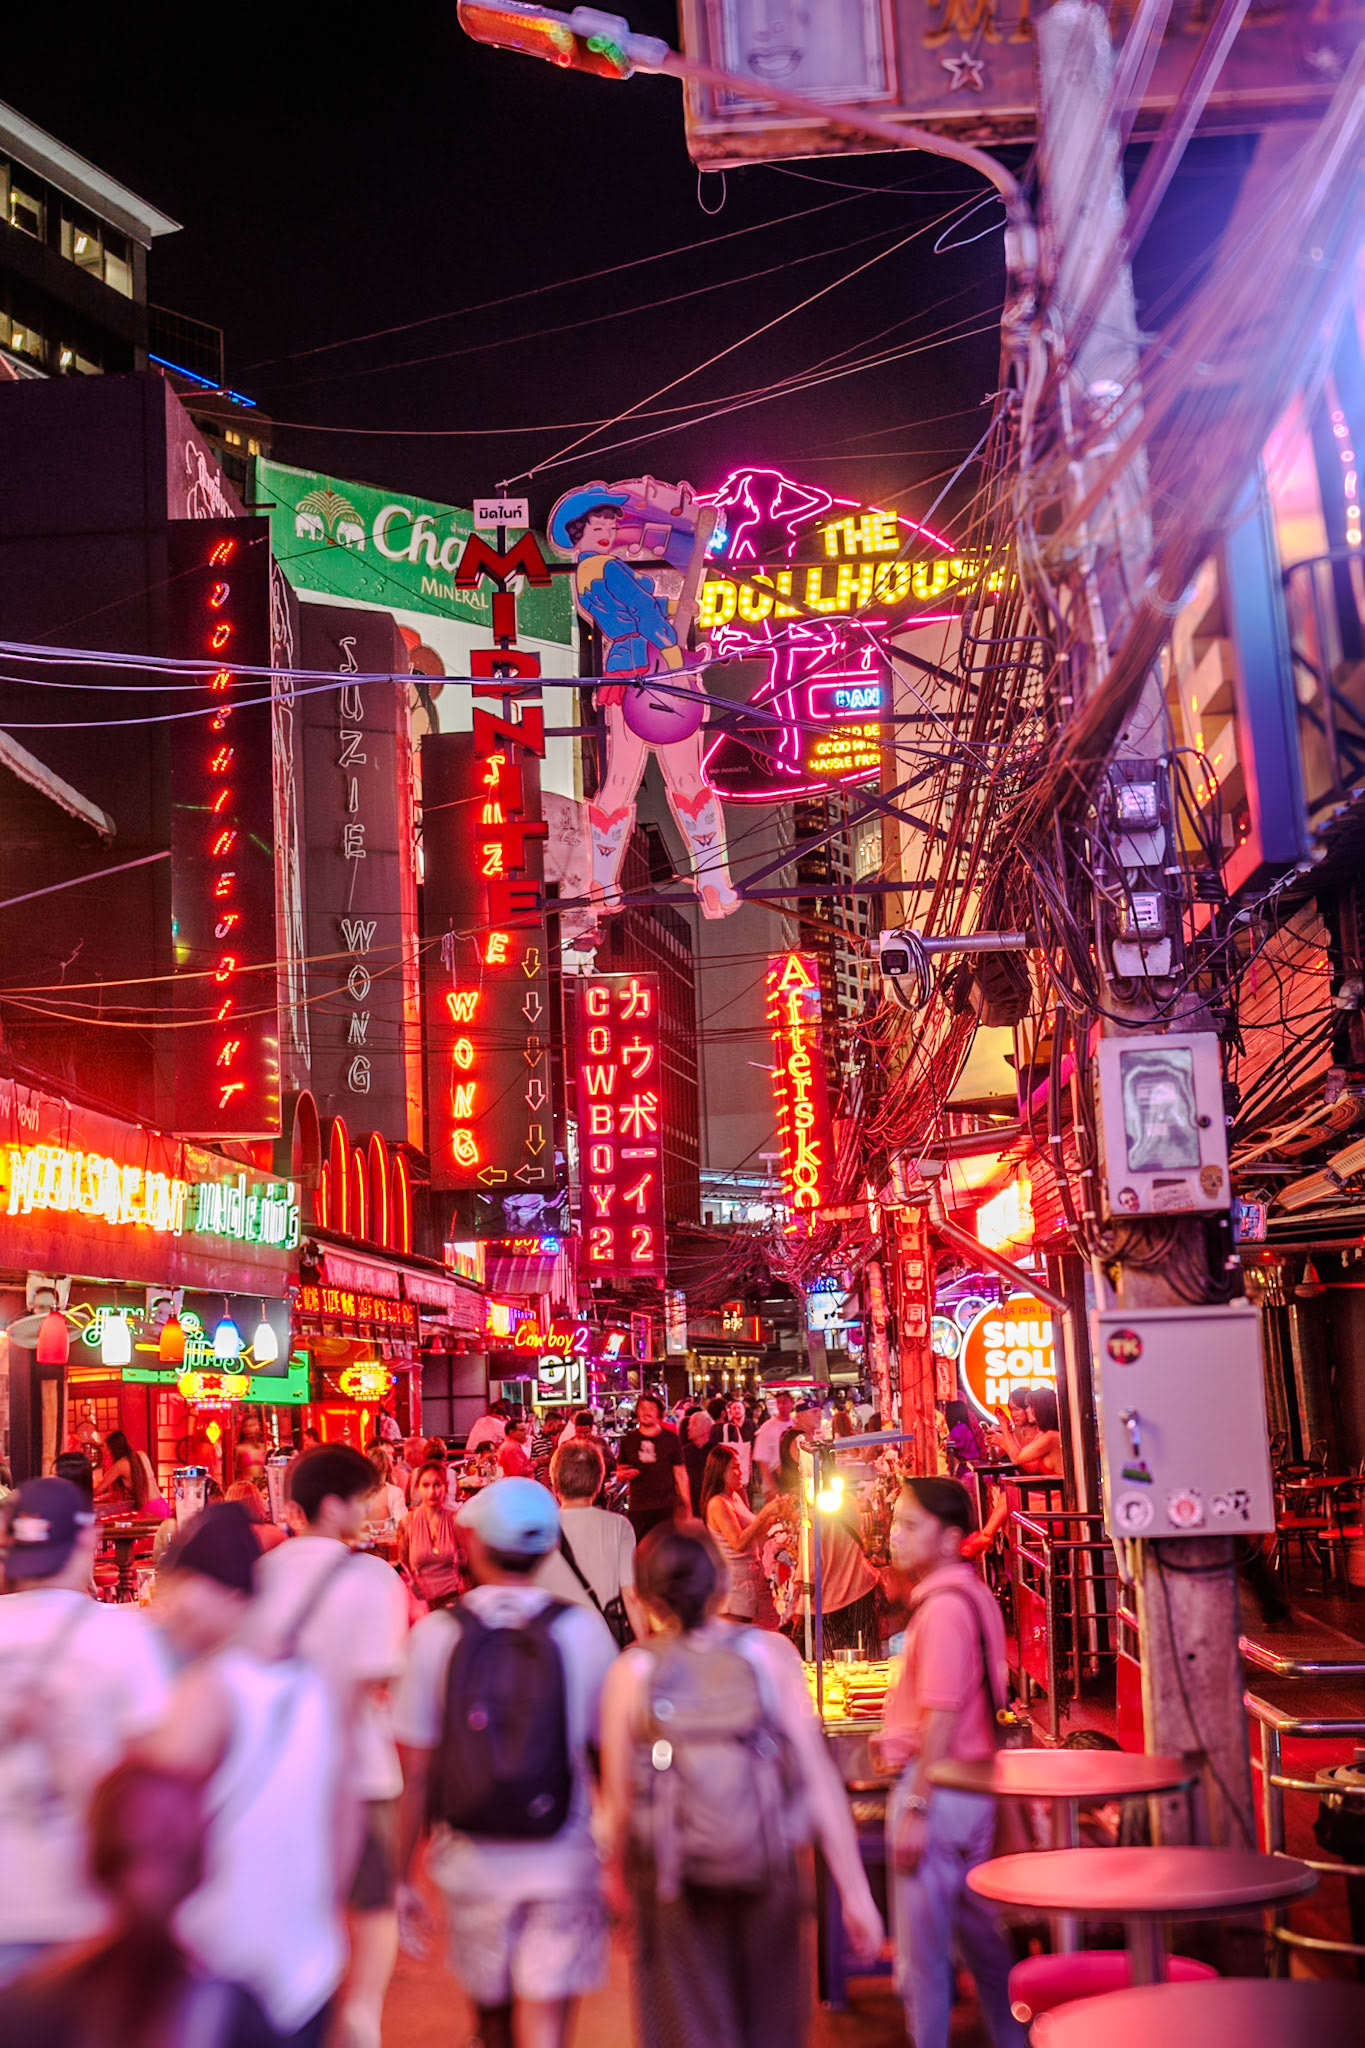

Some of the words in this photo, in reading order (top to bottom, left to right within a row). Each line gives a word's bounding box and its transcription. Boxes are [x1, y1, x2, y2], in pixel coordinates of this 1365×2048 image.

[480, 505, 522, 519] มิดไนท์
[815, 510, 901, 557] THE
[421, 576, 489, 610] MINERAL
[339, 637, 367, 859] SUZIE
[454, 531, 553, 927] MIDNITE
[809, 756, 852, 770] HASSLE
[341, 919, 377, 1094] WONG
[446, 991, 479, 1167] WONG
